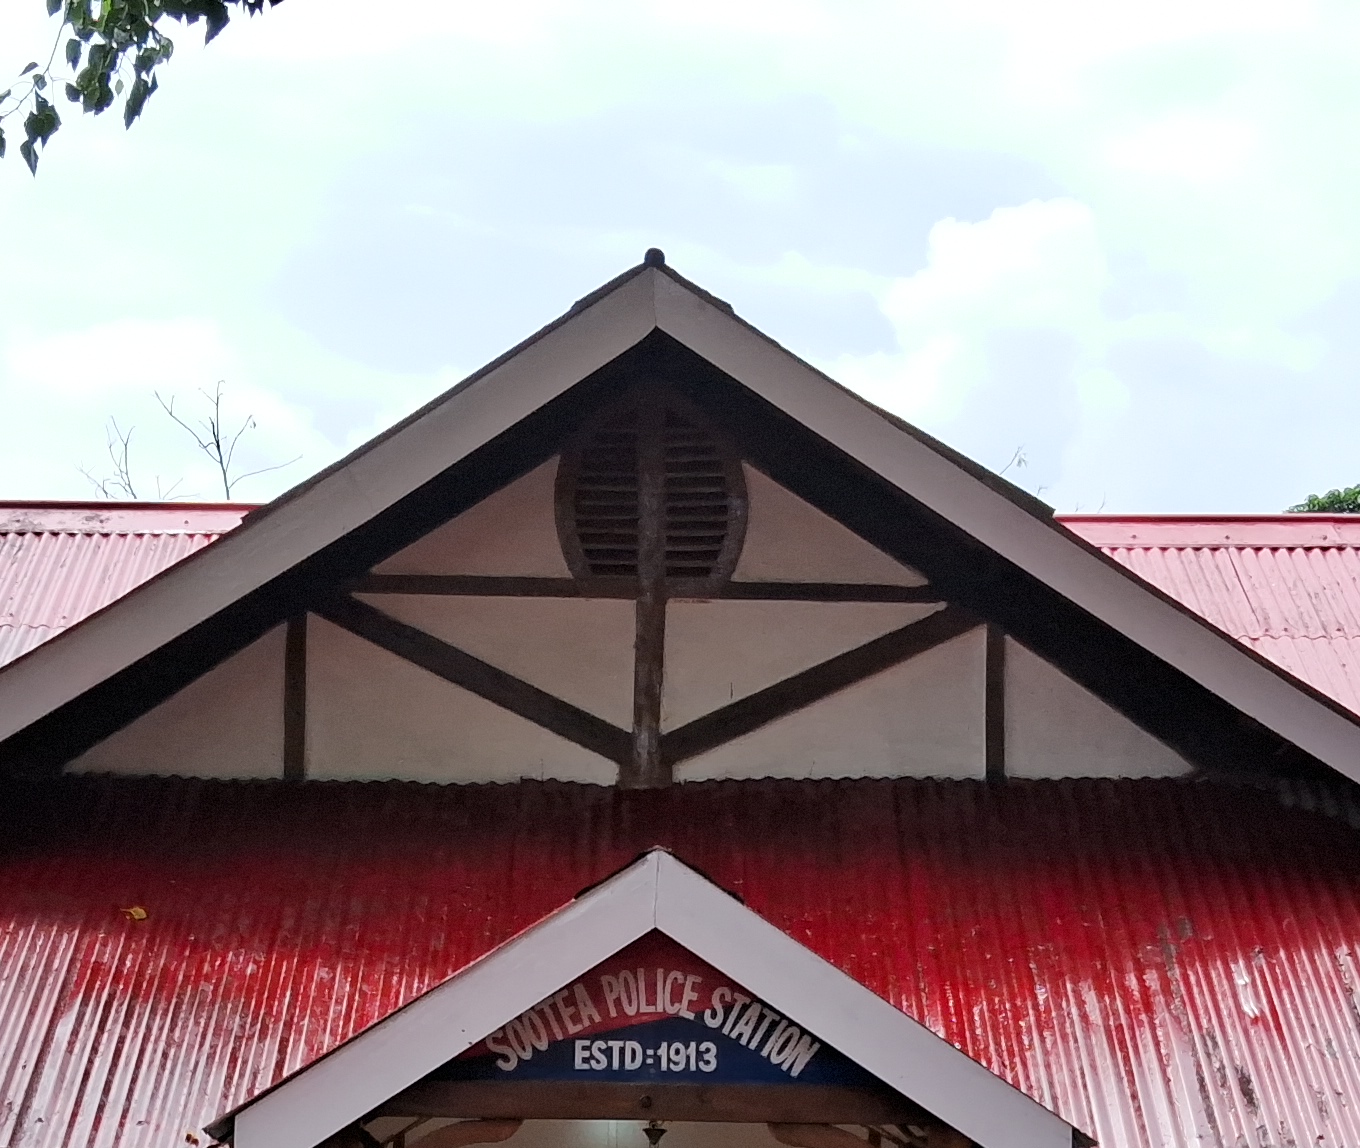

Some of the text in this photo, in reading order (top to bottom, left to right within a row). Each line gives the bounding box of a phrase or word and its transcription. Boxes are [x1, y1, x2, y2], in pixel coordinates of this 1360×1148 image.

[486, 967, 821, 1078] SOOTEA POLICE STATION
[574, 1039, 717, 1073] ESTD:1913
